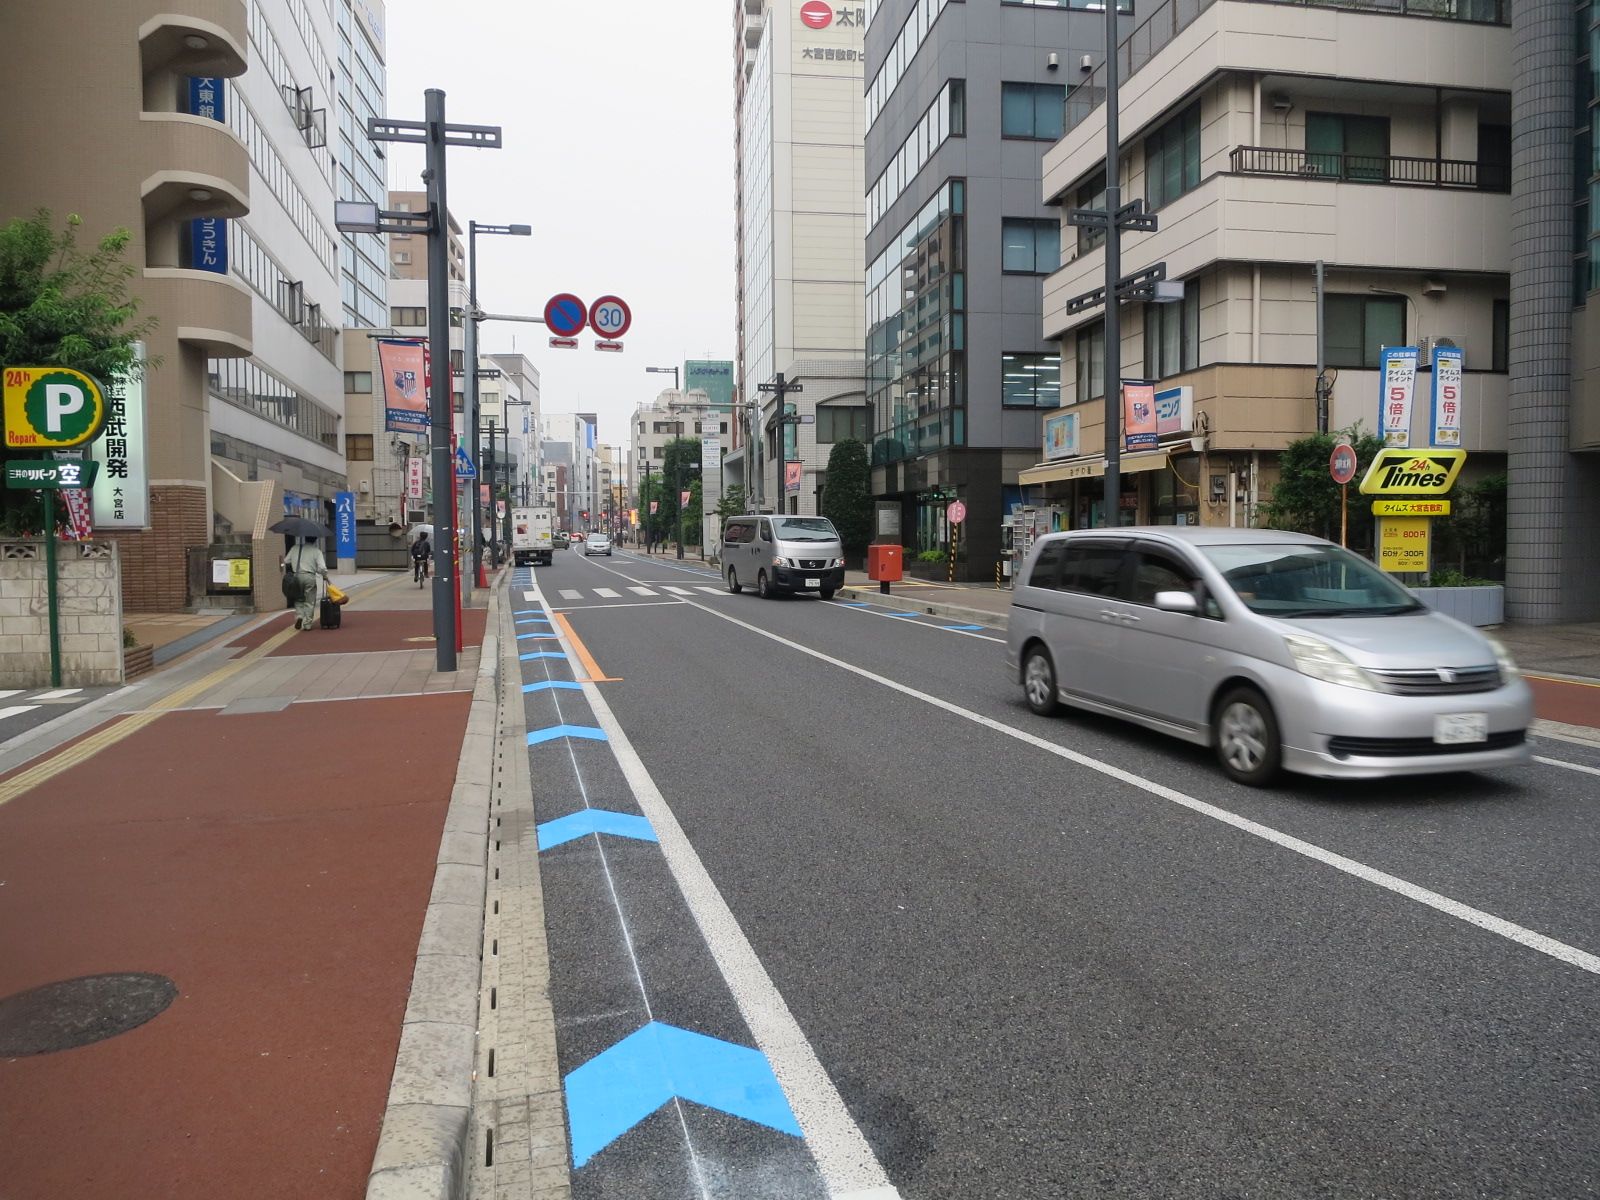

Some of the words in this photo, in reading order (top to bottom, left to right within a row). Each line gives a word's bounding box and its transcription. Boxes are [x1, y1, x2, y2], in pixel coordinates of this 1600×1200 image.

[599, 308, 622, 327] 30
[6, 371, 30, 387] 24h
[46, 384, 84, 432] P
[9, 431, 37, 444] Repark
[106, 397, 128, 478] 西武開発
[9, 469, 57, 480] 三井のリパーク
[58, 463, 80, 484] 空
[1409, 460, 1430, 471] 24h
[113, 487, 124, 520] 大宮店
[1384, 504, 1408, 512] タイムズ
